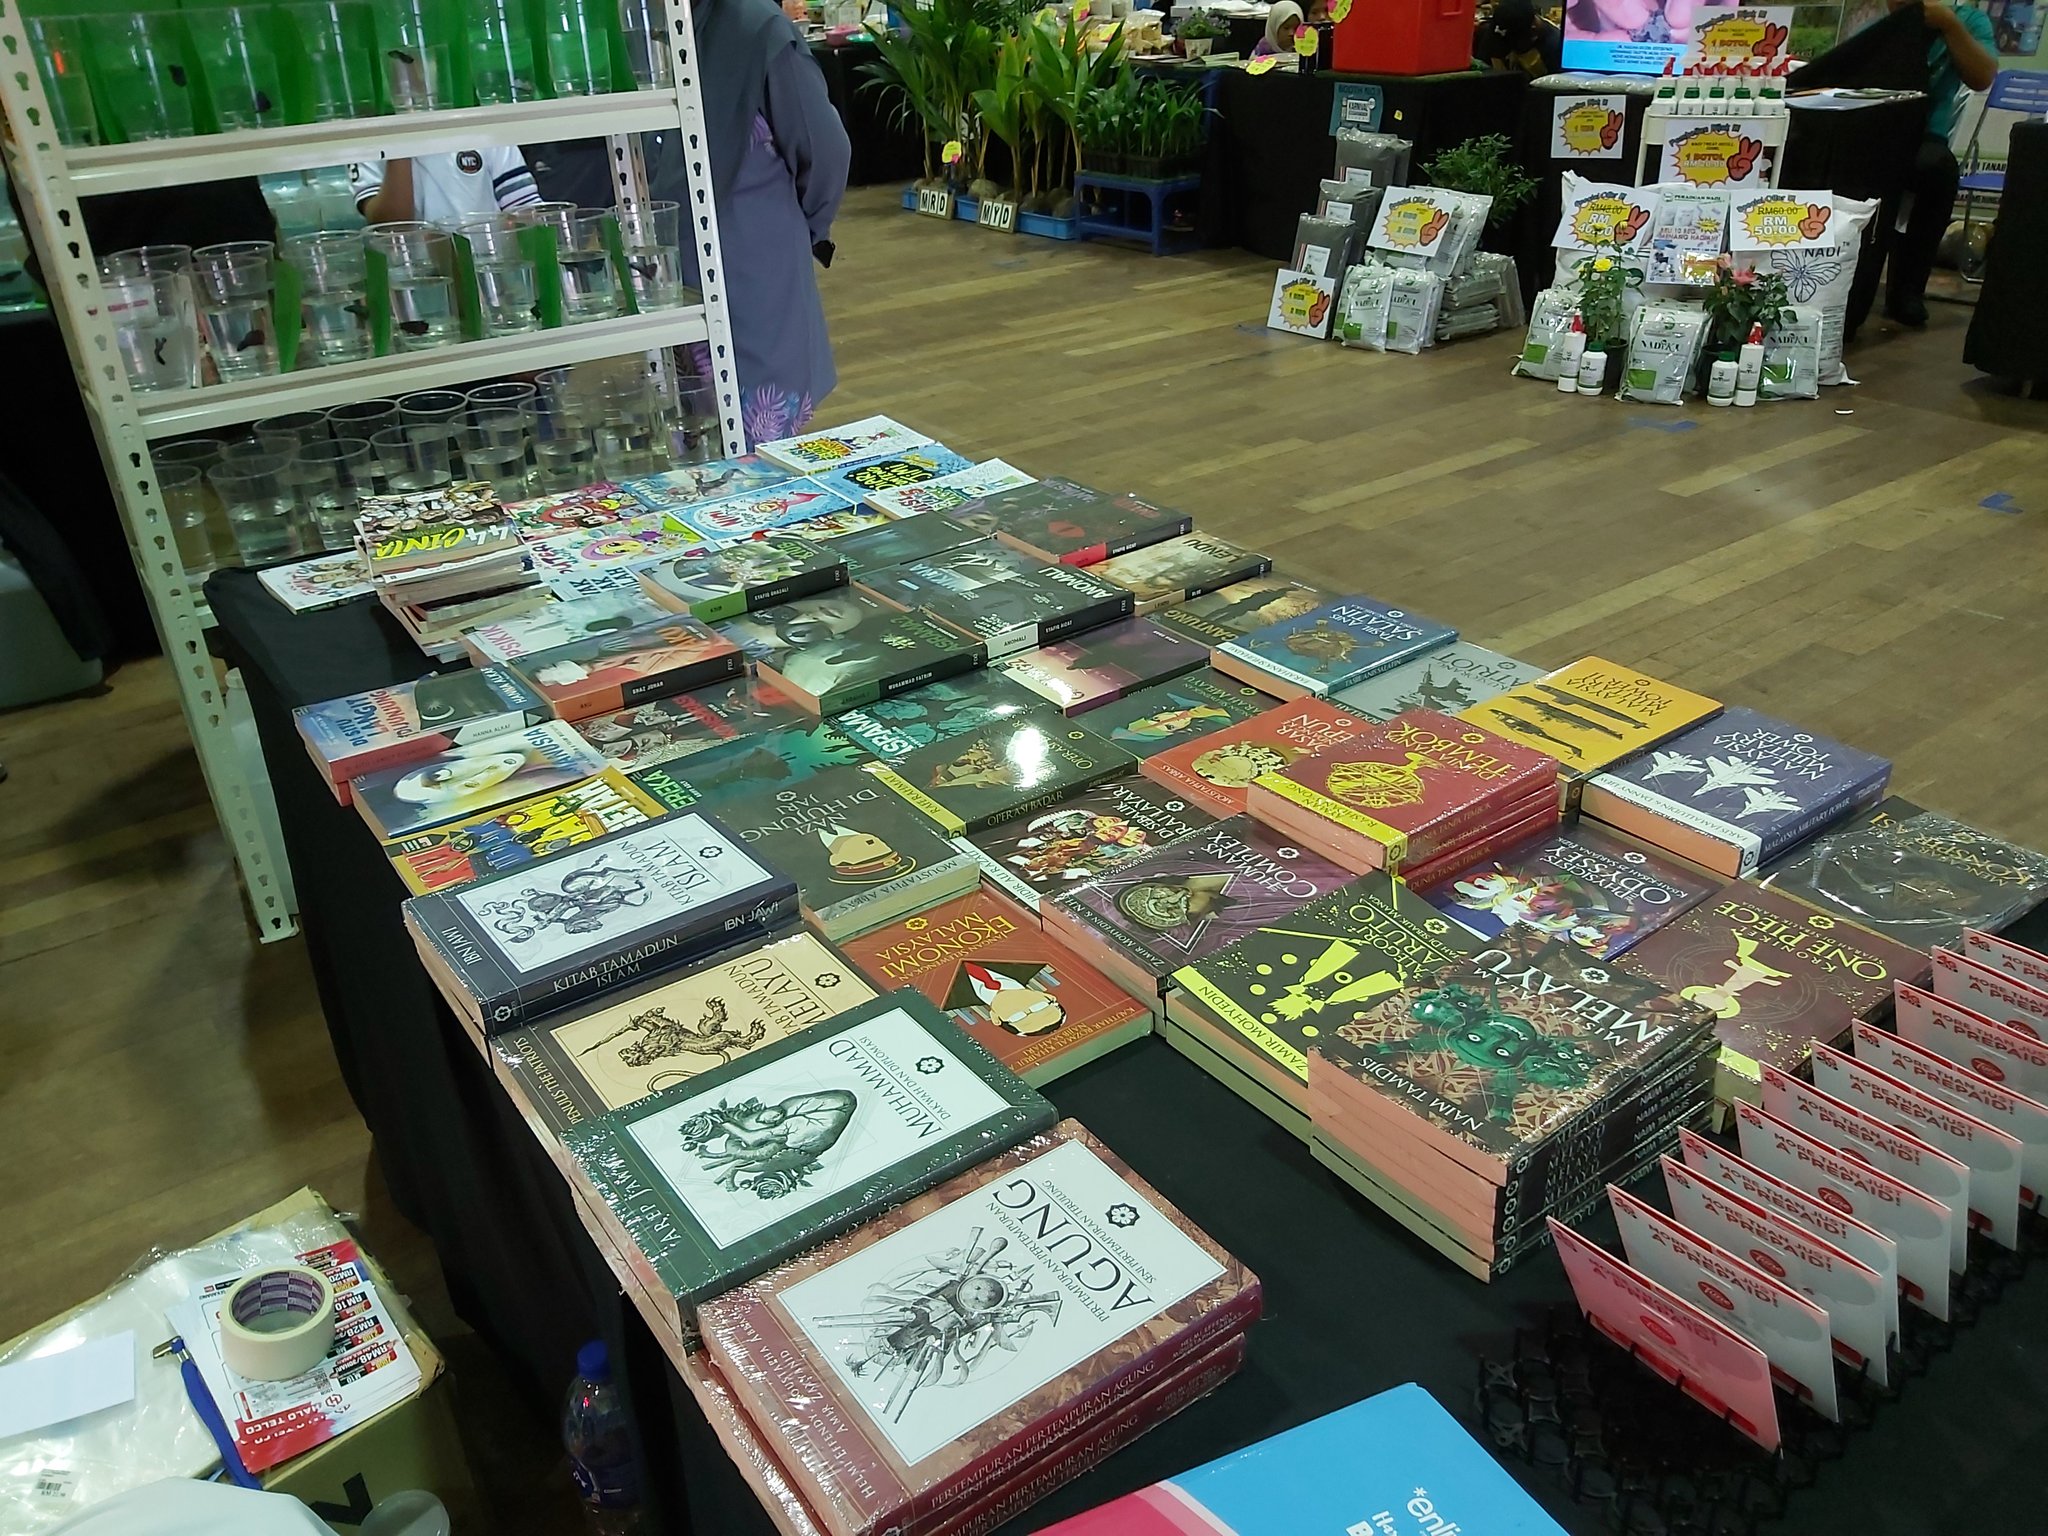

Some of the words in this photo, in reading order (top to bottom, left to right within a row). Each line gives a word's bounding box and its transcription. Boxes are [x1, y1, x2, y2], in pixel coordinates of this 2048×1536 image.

[1588, 212, 1610, 225] RM
[1753, 225, 1798, 236] 50.00
[1762, 216, 1787, 227] RM
[1803, 246, 1843, 259] NADI
[372, 527, 466, 561] CINTA
[465, 524, 509, 546] 44
[1180, 539, 1240, 563] LENDU
[1036, 566, 1114, 600] ANOMALI
[486, 624, 529, 659] PSIKIK
[1163, 608, 1240, 642] GANTUNG
[1331, 604, 1423, 642] SALATIN
[1430, 652, 1530, 688] ATRIOT
[1566, 677, 1661, 718] MALAYSIA
[1572, 676, 1669, 712] MILITARY
[1608, 677, 1674, 706] POWER
[838, 708, 914, 757] ASRAMA
[1388, 721, 1515, 779] TEMBOK
[1749, 727, 1832, 762] POWER
[1440, 752, 1499, 782] DUNIA
[1711, 734, 1827, 782] MALAYSIA
[1719, 729, 1834, 774] MILITARY
[775, 793, 820, 816] JARI
[847, 787, 880, 807] DI
[987, 800, 1031, 827] OPERASI
[1030, 789, 1064, 812] BADAR
[1110, 785, 1163, 816] LAYAR
[1183, 775, 1235, 805] MOUSTAPHA
[738, 798, 849, 844] HUJUNG
[794, 811, 847, 837] NAZI
[1112, 799, 1163, 830] SEBALIK
[619, 839, 661, 885] TAMADUN
[642, 839, 712, 891] ISLAM
[879, 859, 958, 896] MOUSTAPHA
[1205, 828, 1318, 899] COMPLEX
[1543, 845, 1672, 906] ODYSSEY
[659, 880, 696, 907] KITAB
[837, 890, 878, 912] ABBAS
[1367, 893, 1401, 920] MANGA
[1741, 900, 1780, 921] MANGA
[724, 913, 749, 933] IBN
[747, 904, 780, 926] JAWI
[874, 911, 986, 961] MALAYSIA
[1347, 903, 1444, 965] ARUTO
[1400, 916, 1431, 941] SEBALIK
[1712, 900, 1810, 949] PIECE
[441, 926, 467, 951] JAWI
[459, 944, 483, 965] IBN
[878, 914, 1019, 979] EKONOMI
[1134, 944, 1167, 969] ZAMIR
[1355, 924, 1429, 975] ALEGORI
[1737, 924, 1838, 974] KRONIKEL
[553, 966, 599, 994] KITAB
[599, 934, 679, 974] TAMADUN
[596, 961, 642, 988] ISLAM
[1805, 939, 1888, 982] ONE
[722, 963, 779, 1018] TAMADUN
[1470, 946, 1666, 1047] MELAYU
[1471, 965, 1537, 1002] ALAM
[1196, 983, 1266, 1042] MOHYEDIN
[1544, 1001, 1630, 1048] MISTIK
[858, 1036, 899, 1074] DIPLOMASI
[1262, 1035, 1309, 1074] ZAMIR
[826, 1038, 943, 1140] MUHAMMAD
[892, 1067, 912, 1088] DAN
[1354, 1055, 1430, 1104] TAMDJIS
[905, 1079, 952, 1121] DAKWAH
[1429, 1091, 1485, 1132] NAIM
[1041, 1178, 1084, 1218] TERULUNG
[991, 1178, 1156, 1312] AGUNG
[1081, 1214, 1138, 1269] PERTEMPURAN
[1136, 1264, 1158, 1285] SENI
[244, 1416, 286, 1435] TELCO
[286, 1403, 322, 1422] HALO
[929, 1442, 1025, 1508] PERTEMPURAN
[1023, 1386, 1112, 1452] PERTEMPURAN
[1111, 1359, 1156, 1394] AGUNG
